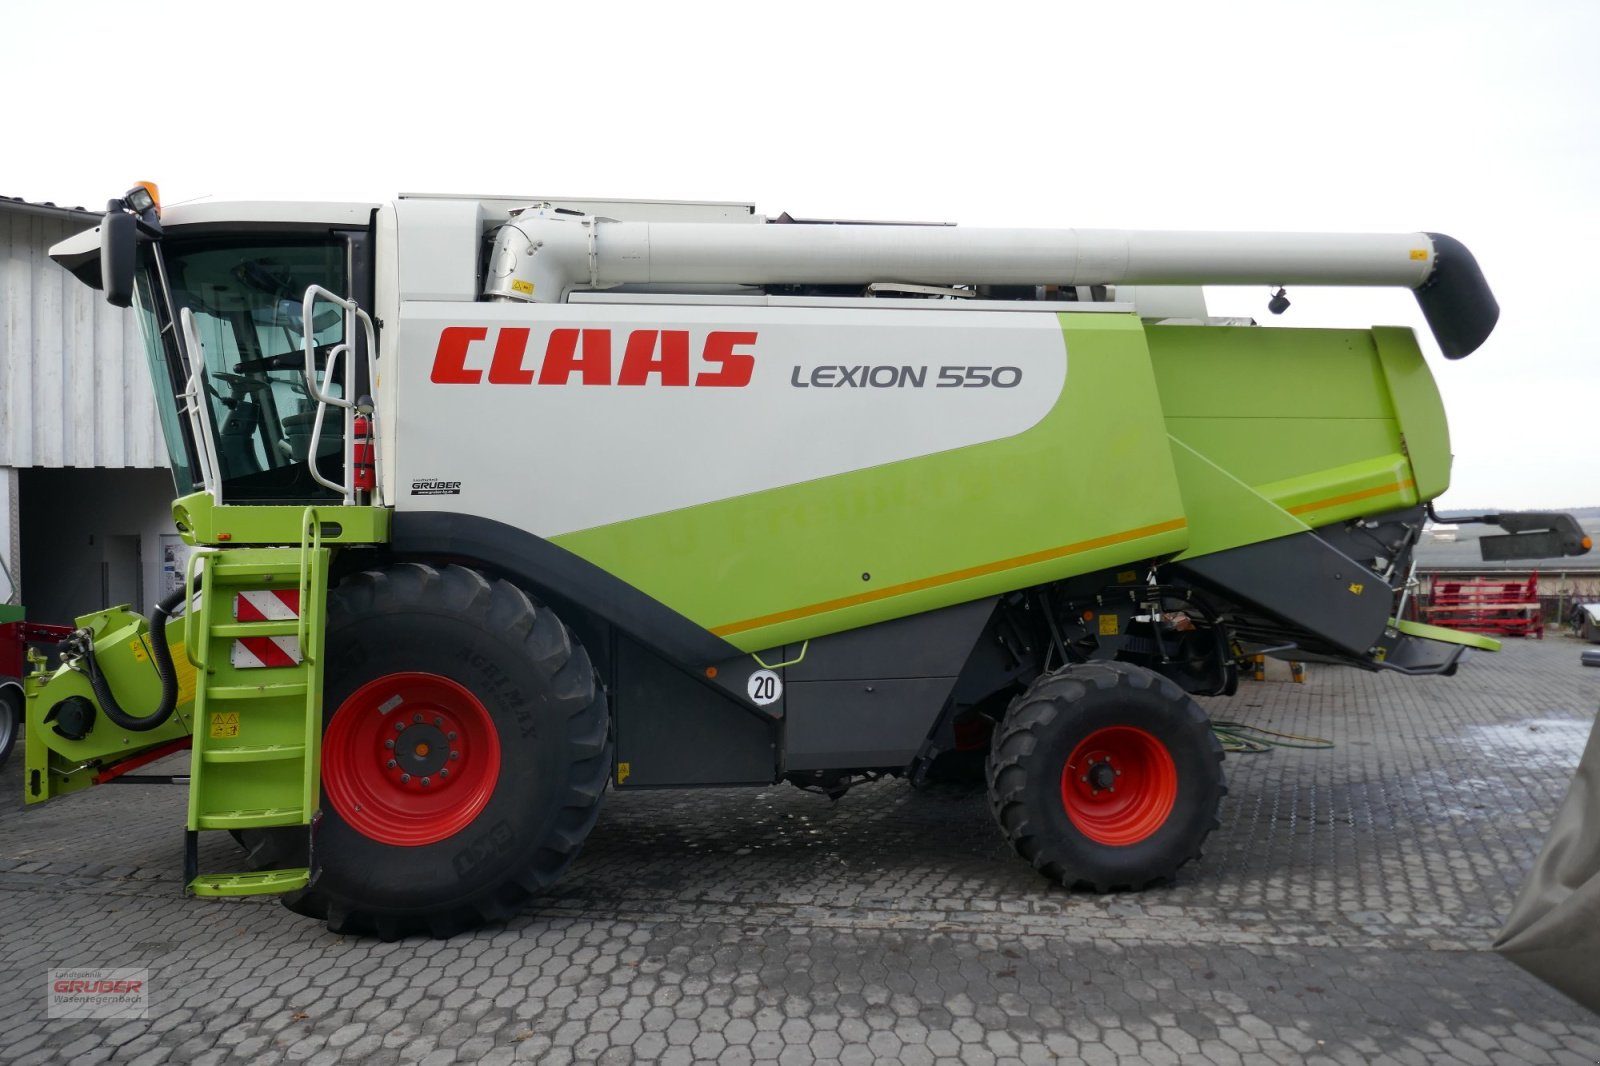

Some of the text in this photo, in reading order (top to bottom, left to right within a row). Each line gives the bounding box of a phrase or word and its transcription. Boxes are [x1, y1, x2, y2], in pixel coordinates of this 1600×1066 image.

[430, 327, 758, 387] CLAAS
[791, 366, 1022, 388] LEXION 550
[411, 481, 461, 489] GRUBER
[753, 676, 775, 700] 20
